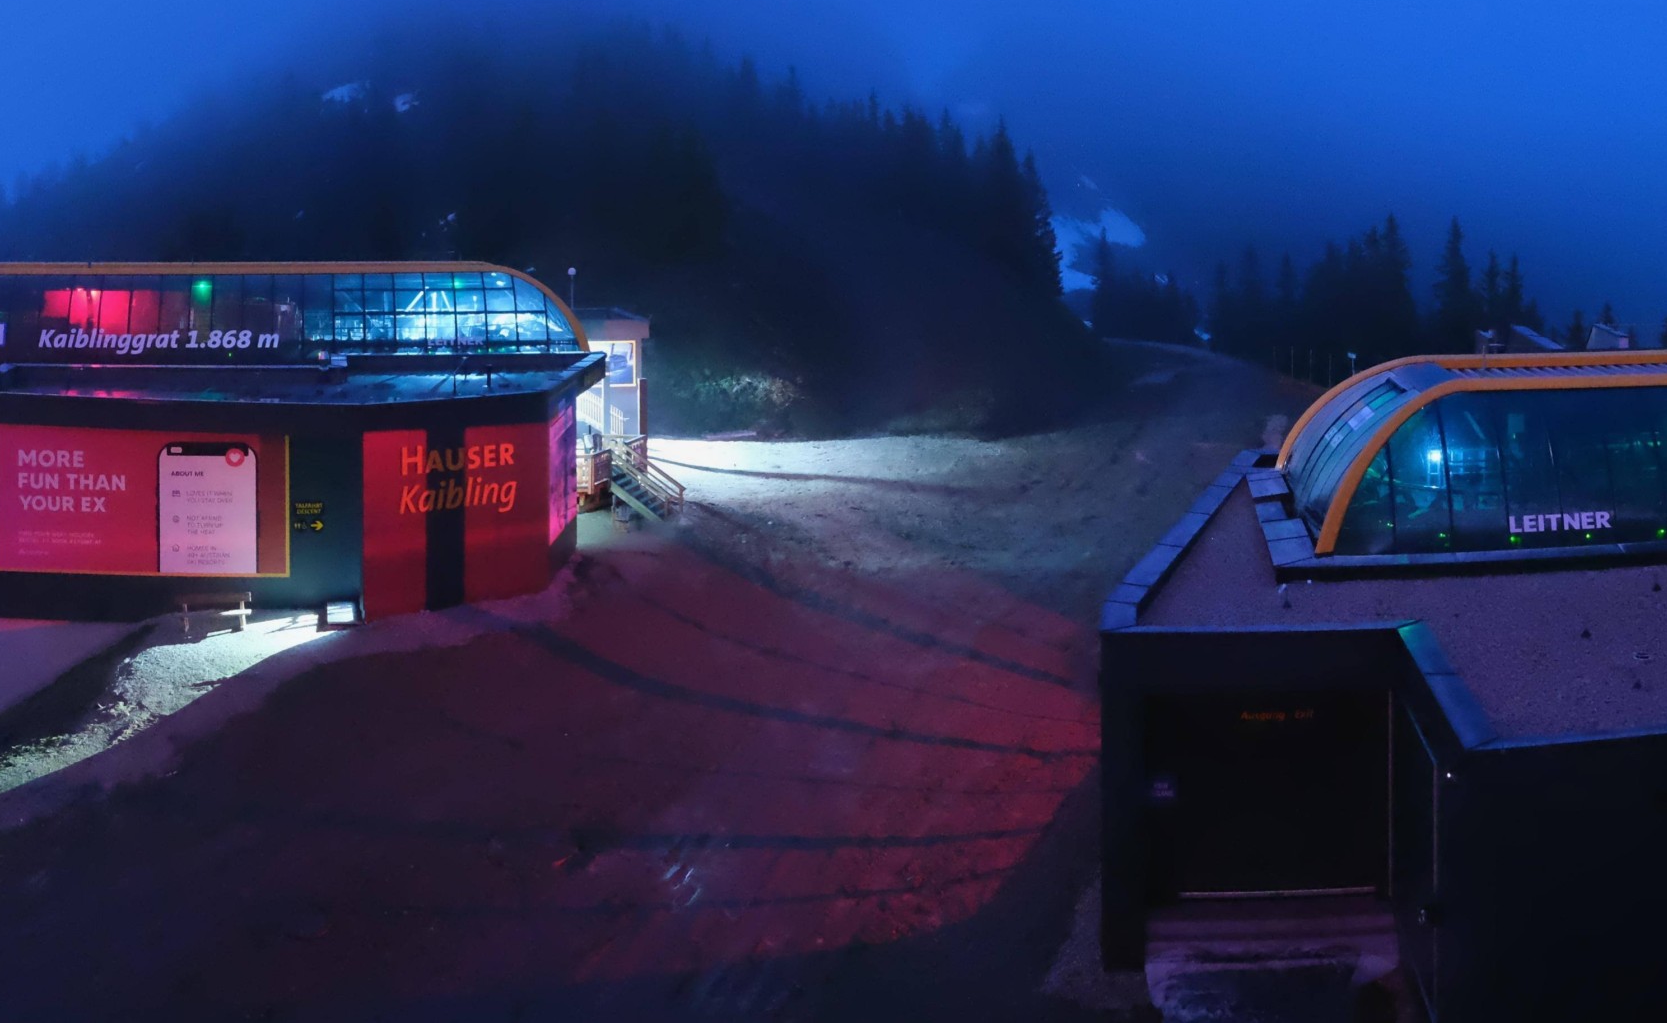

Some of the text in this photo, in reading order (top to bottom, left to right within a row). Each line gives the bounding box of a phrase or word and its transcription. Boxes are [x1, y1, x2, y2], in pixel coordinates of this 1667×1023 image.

[38, 328, 280, 355] Kaiblinggrat 1.868 m
[427, 337, 484, 346] LEITNER
[17, 449, 85, 468] MORE
[401, 443, 515, 476] HAUSER
[17, 472, 126, 492] FUN THAN
[20, 495, 106, 513] YOUR EX
[399, 477, 517, 515] Kaibling
[1508, 511, 1612, 533] LEITNER
